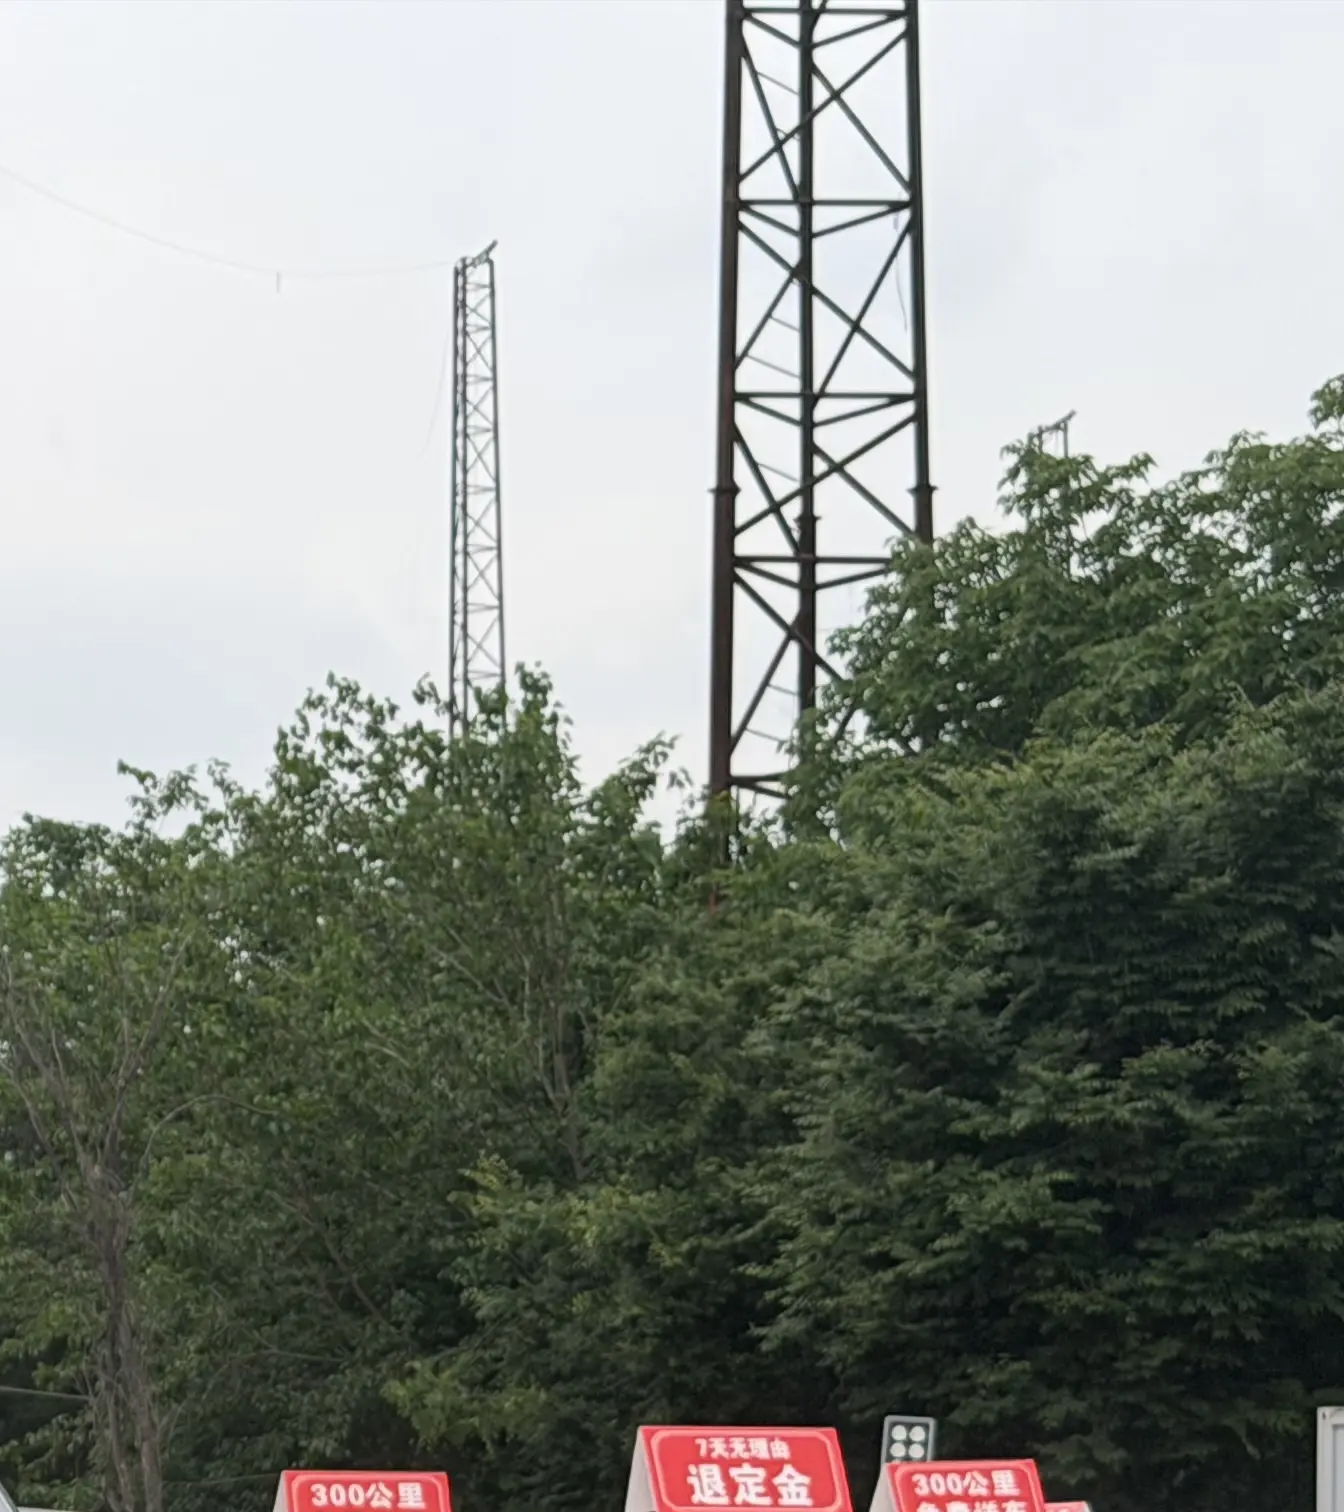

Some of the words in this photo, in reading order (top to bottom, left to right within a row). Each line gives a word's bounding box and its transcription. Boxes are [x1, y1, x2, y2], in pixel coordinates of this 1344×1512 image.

[695, 1437, 791, 1460] 7天无理由
[310, 1481, 427, 1510] 300公里
[687, 1462, 814, 1507] 退定金
[912, 1469, 1021, 1497] 300公里
